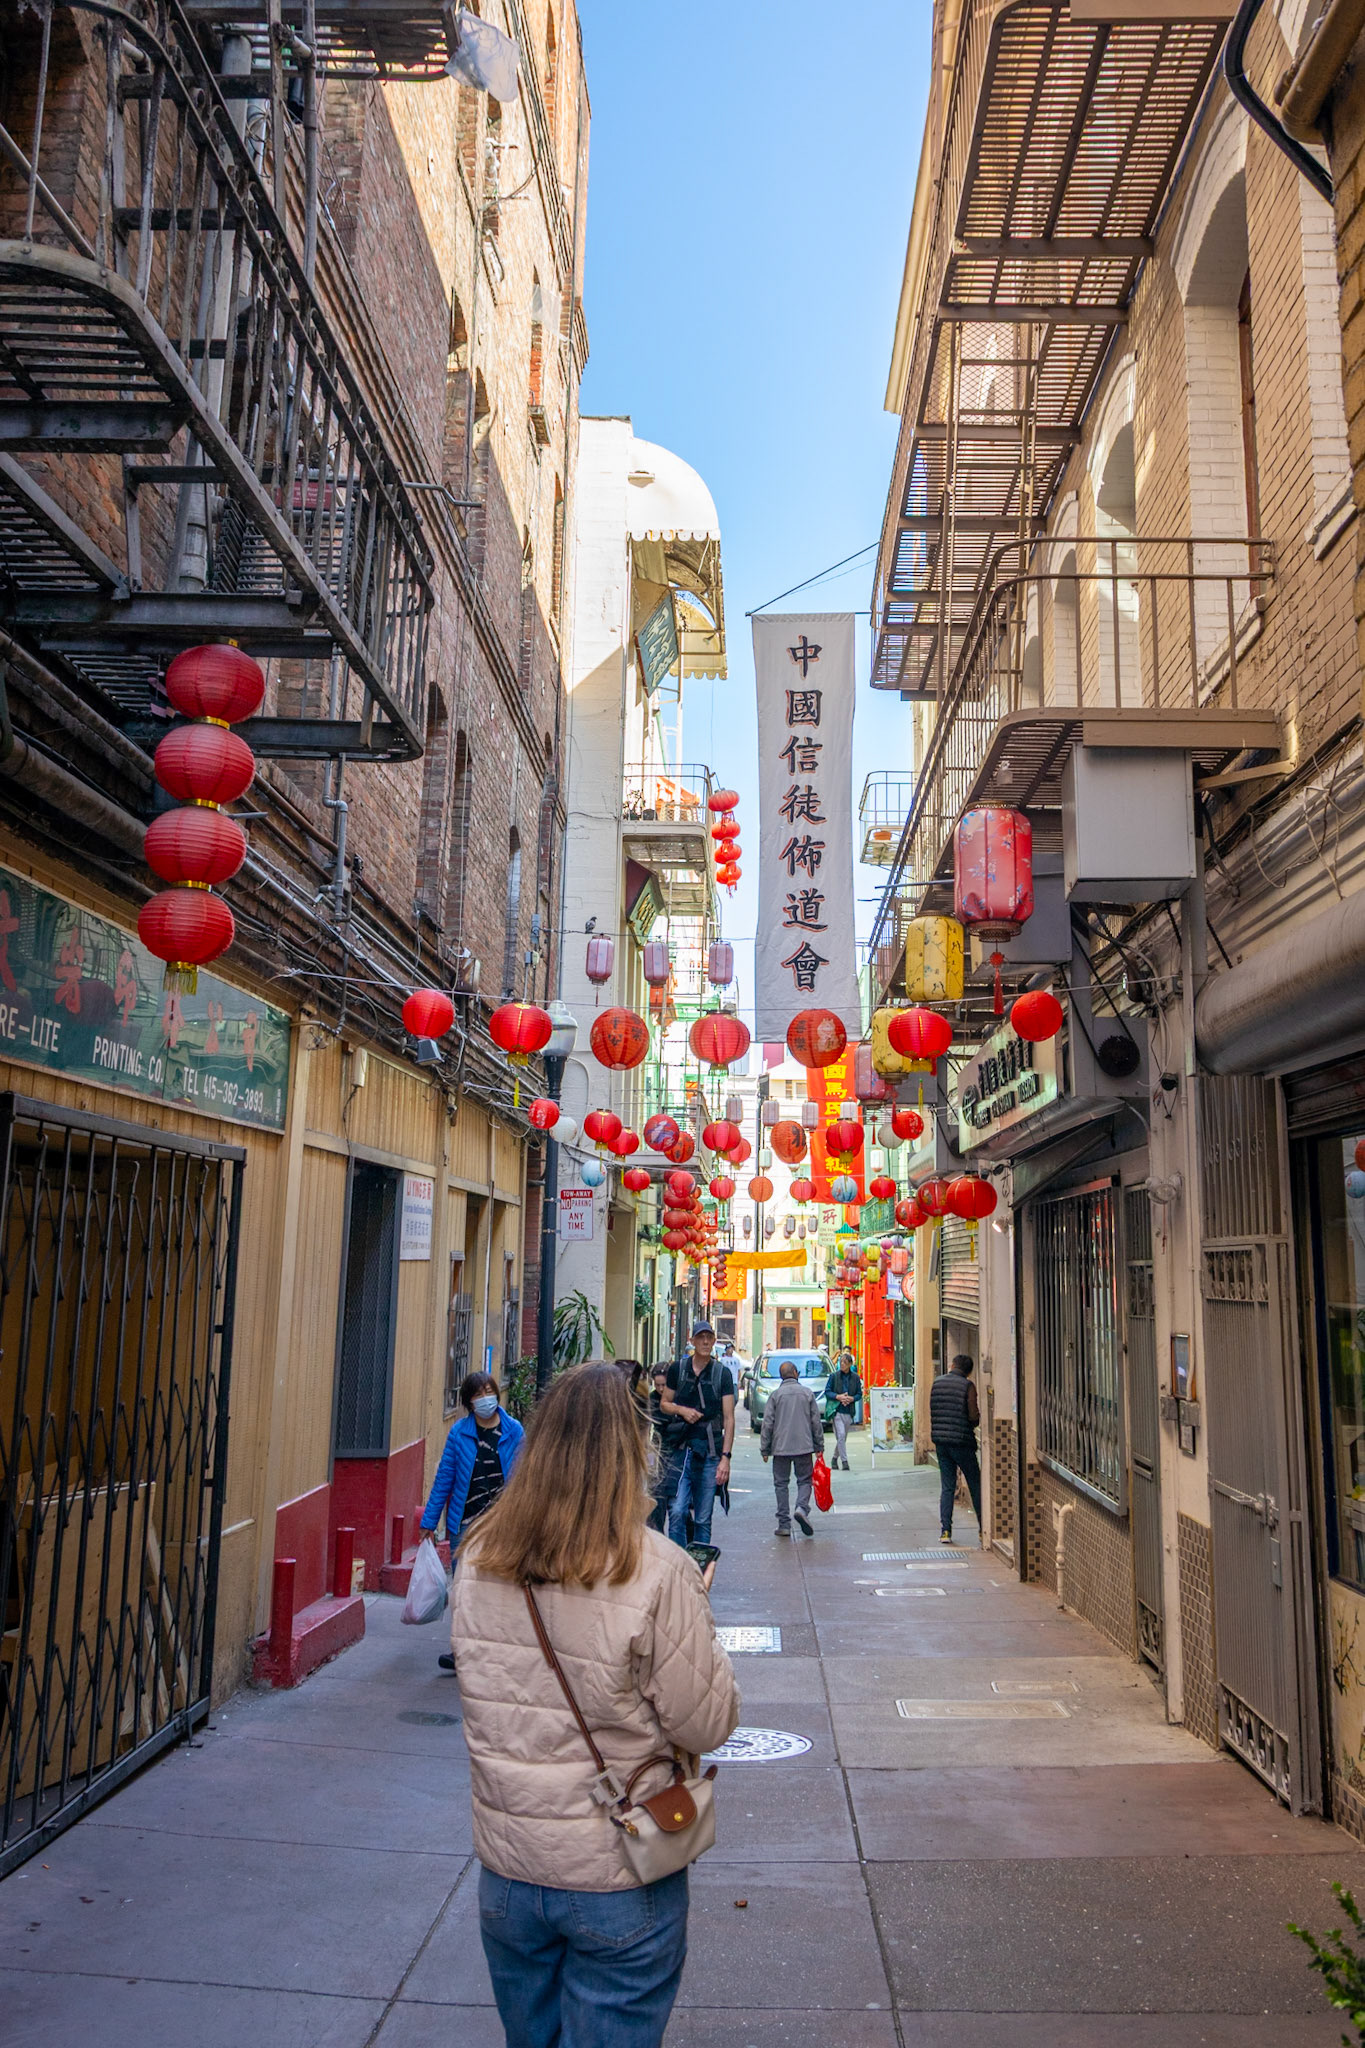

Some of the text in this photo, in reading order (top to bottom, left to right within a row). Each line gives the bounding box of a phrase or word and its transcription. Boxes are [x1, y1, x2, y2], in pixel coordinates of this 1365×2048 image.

[778, 635, 830, 992] 中國信徒佈道會
[92, 1035, 142, 1077] PRINTING
[148, 1056, 163, 1084] CO.
[183, 1067, 199, 1096] TEL
[203, 1074, 264, 1113] 415-362-3893
[560, 1199, 571, 1209] NO
[568, 1222, 585, 1230] TIME
